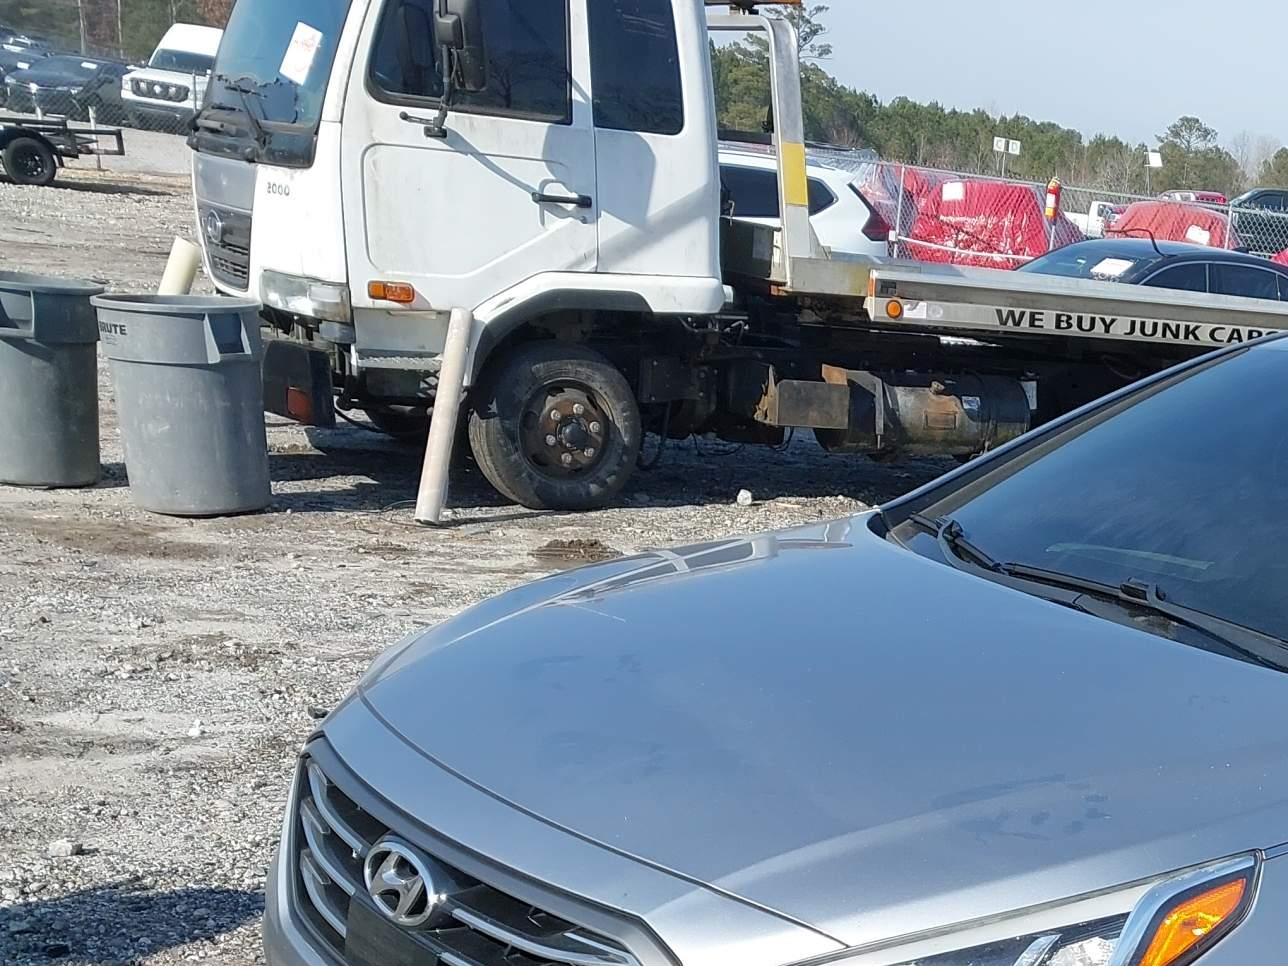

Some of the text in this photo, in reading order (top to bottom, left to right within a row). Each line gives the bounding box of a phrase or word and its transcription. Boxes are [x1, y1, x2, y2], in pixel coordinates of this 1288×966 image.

[995, 308, 1044, 329] WE
[1054, 312, 1118, 334] BUY
[1124, 319, 1203, 342] JUNK
